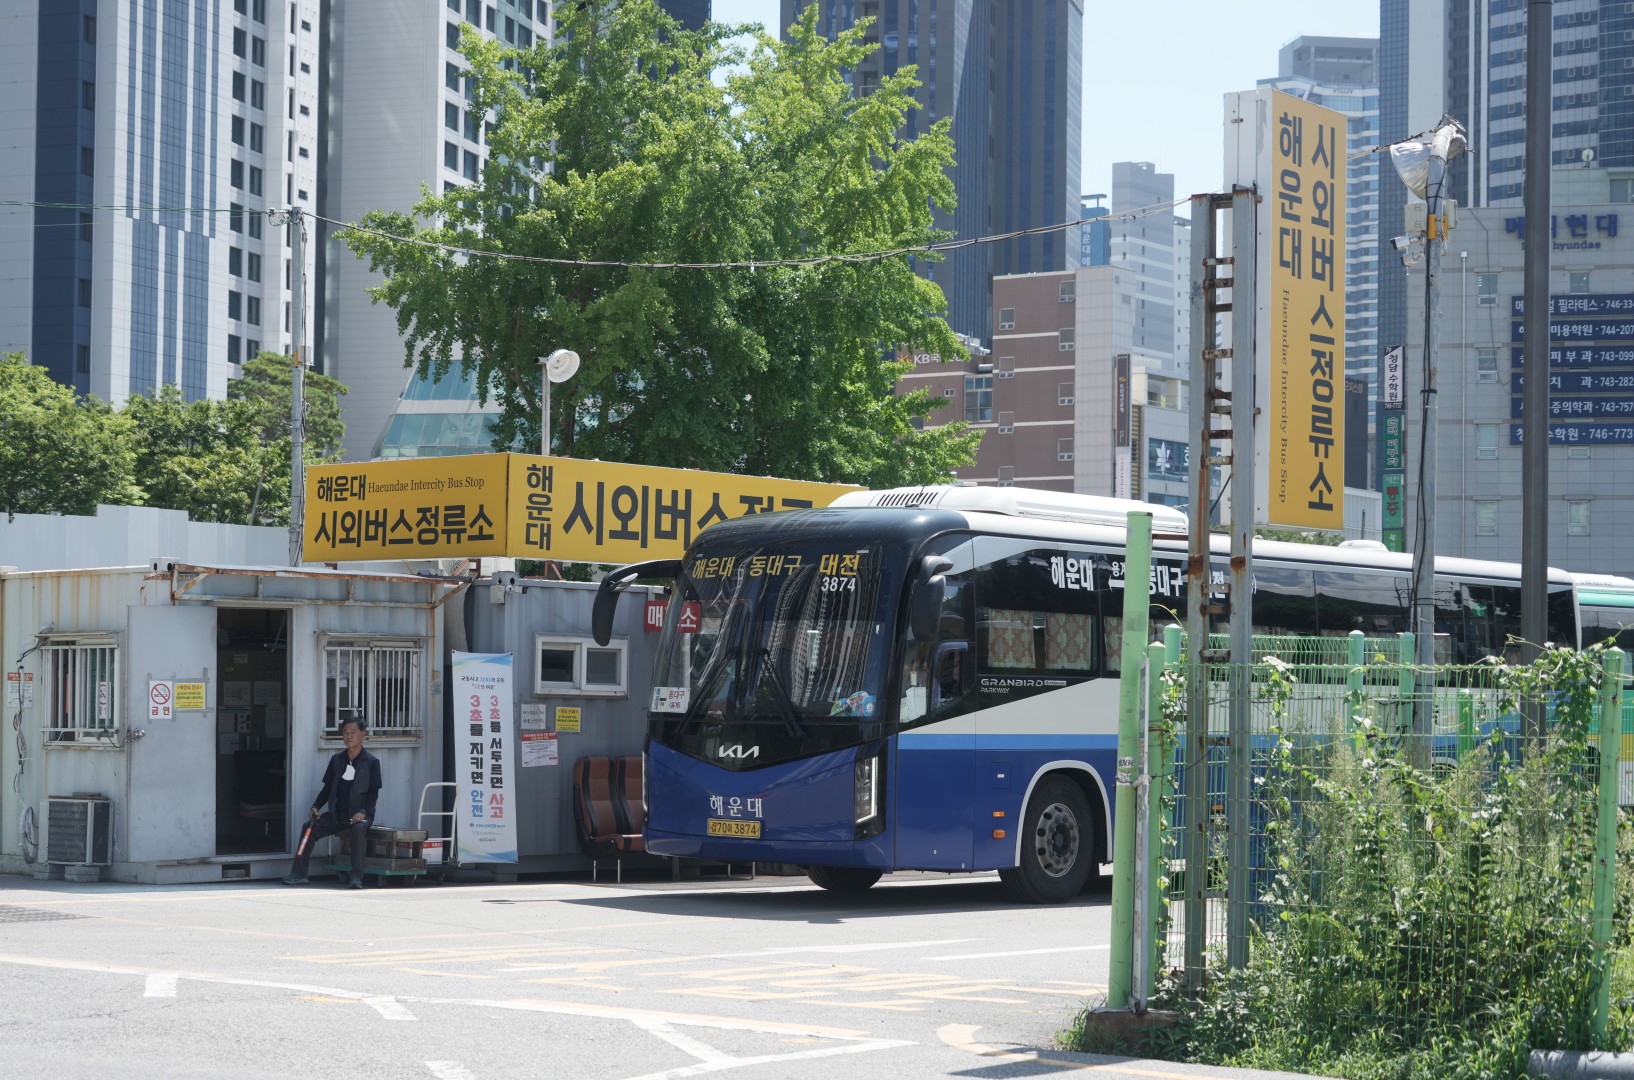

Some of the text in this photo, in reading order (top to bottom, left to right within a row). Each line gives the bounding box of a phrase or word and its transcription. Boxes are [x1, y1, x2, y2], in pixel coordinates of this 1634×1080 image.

[1279, 112, 1303, 280] 해운대
[1308, 123, 1336, 511] 시외버스정류소
[1558, 298, 1599, 313] 필라테스
[1606, 299, 1634, 309] 746-33
[1279, 288, 1290, 503] Haeundae Intercity Bus Stop
[317, 474, 367, 502] 해운대
[368, 476, 485, 493] Haeundae Intercity Bus Stop
[525, 463, 553, 551] 해운대
[313, 503, 495, 549] 시외버스정류소
[692, 553, 860, 579] 해운대 동대구 대전
[1050, 556, 1094, 592] 해운대
[821, 576, 857, 592] 3874
[647, 605, 697, 628] 매소
[980, 678, 1044, 687] GRANBIRD
[489, 694, 502, 733] 3초를
[469, 694, 484, 818] 3초를 지키면 안전
[489, 737, 504, 789] 서두르면
[718, 745, 760, 759] KIA
[488, 793, 504, 819] 사고
[709, 794, 763, 818] 해운대
[734, 823, 757, 836] 3874
